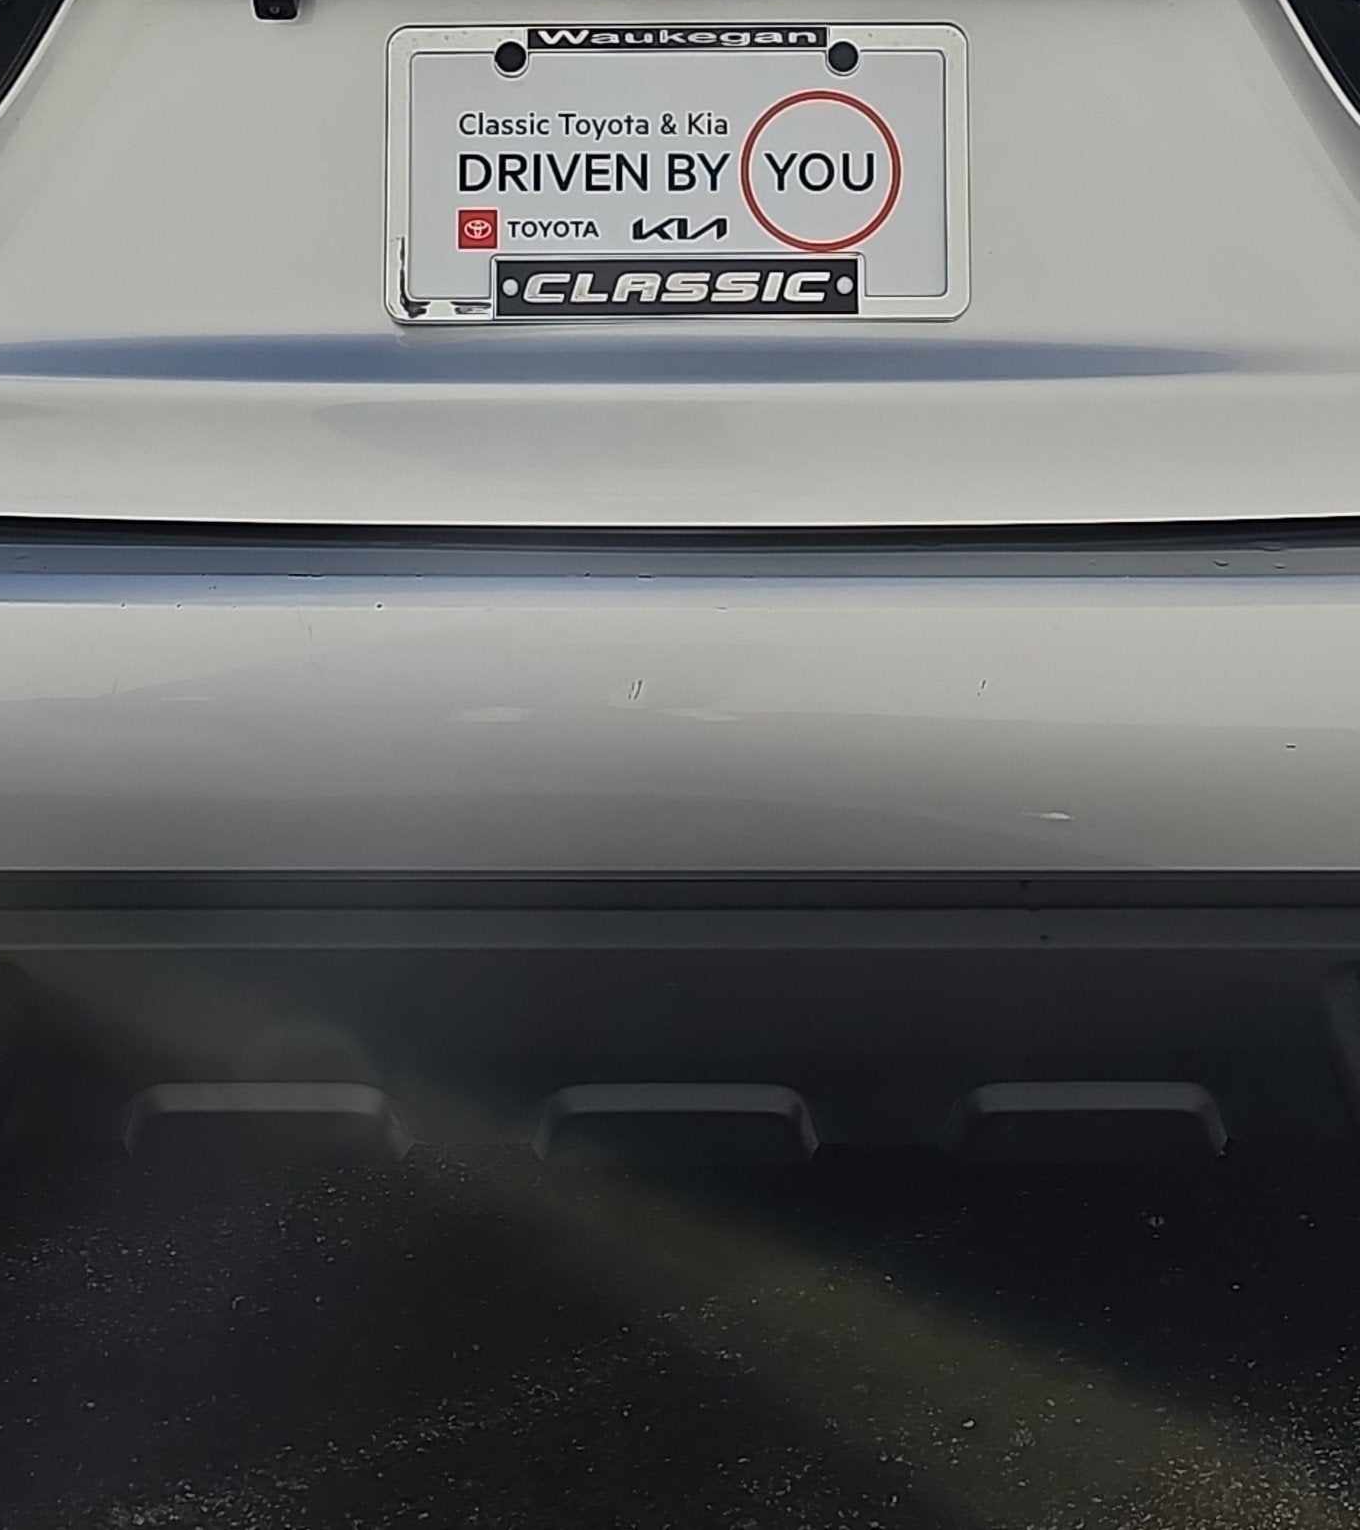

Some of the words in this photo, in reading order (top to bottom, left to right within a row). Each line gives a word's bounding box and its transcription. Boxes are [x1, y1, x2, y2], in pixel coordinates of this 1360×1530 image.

[537, 29, 818, 47] Waukegan
[458, 114, 550, 135] Classic
[558, 114, 649, 141] Toyota
[660, 114, 678, 135] &
[687, 113, 729, 136] Kia
[458, 154, 648, 192] DRIVEN
[667, 154, 730, 191] BY
[763, 153, 875, 192] YOU
[507, 220, 600, 239] TOYOTA
[522, 273, 831, 303] CLASSIC
